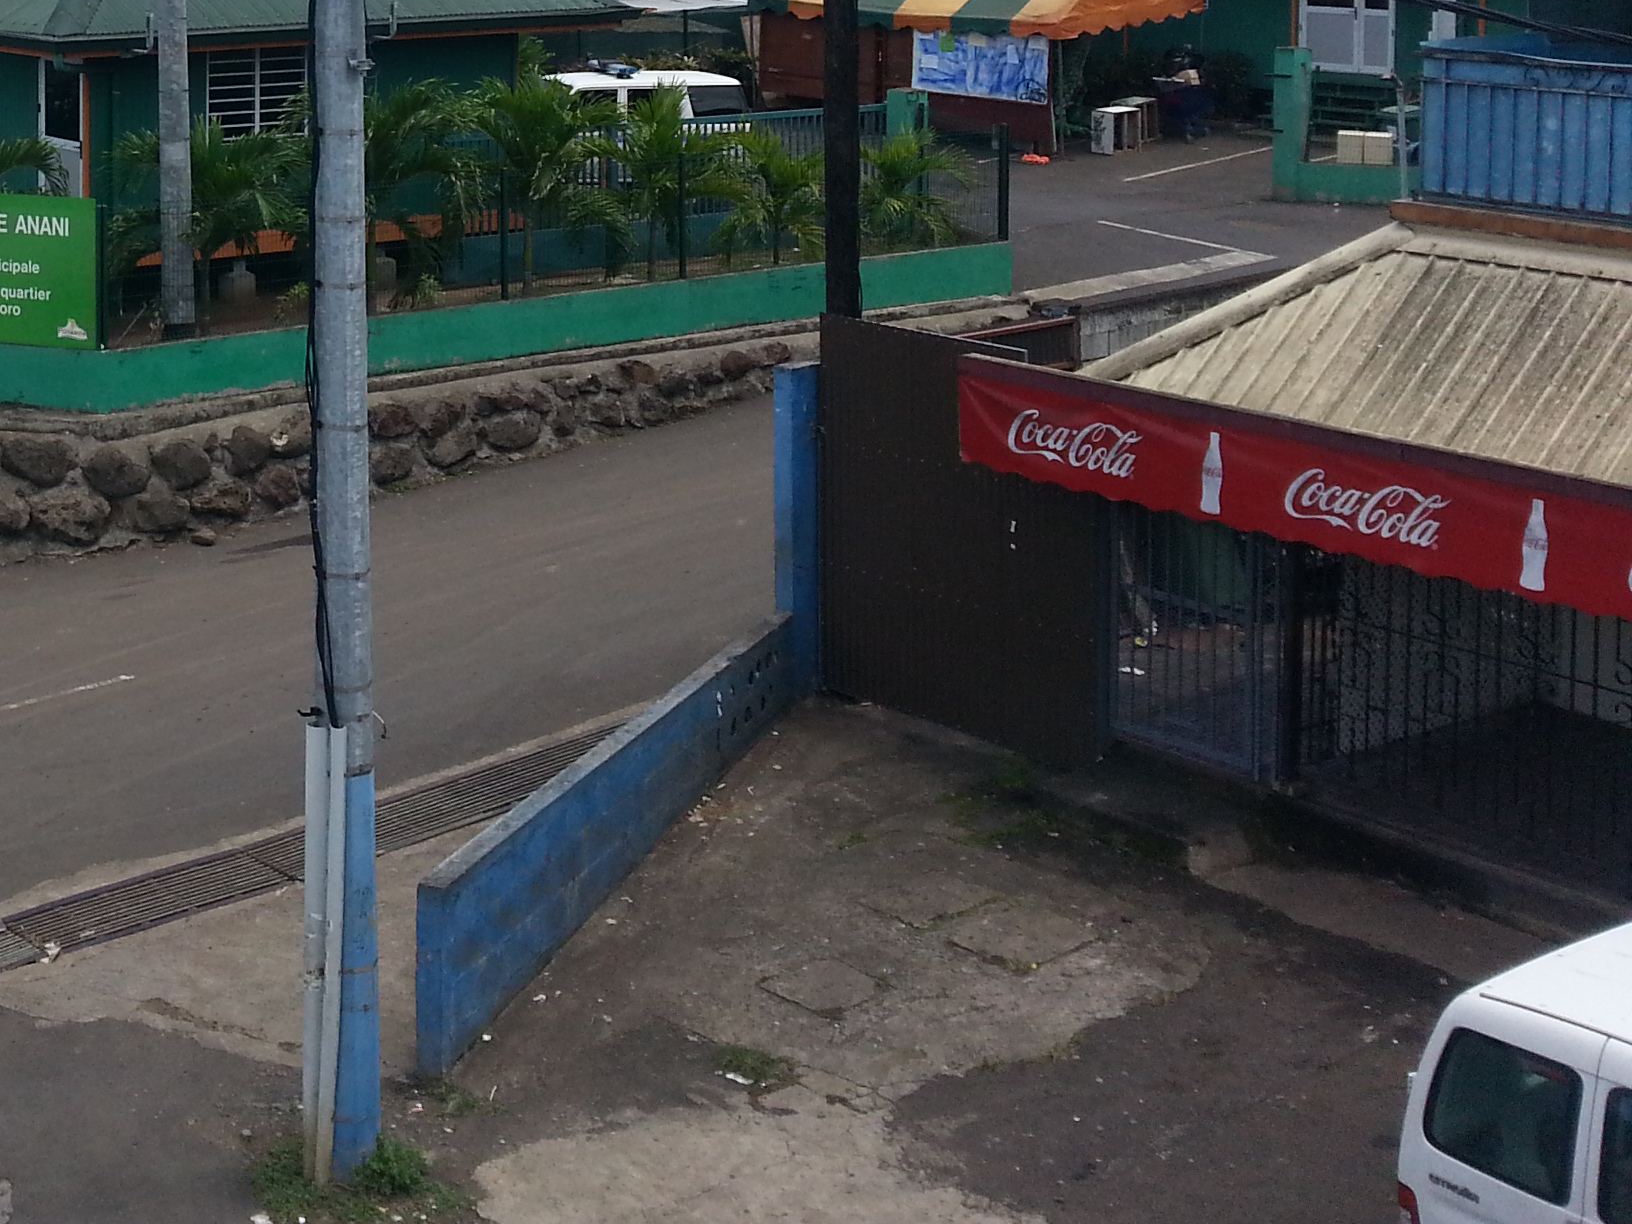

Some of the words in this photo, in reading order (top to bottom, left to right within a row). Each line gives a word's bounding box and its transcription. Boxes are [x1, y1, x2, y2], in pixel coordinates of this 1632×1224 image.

[14, 214, 70, 237] ANANI
[0, 287, 51, 301] quartier
[1007, 409, 1143, 478] Coca-Cola
[1284, 468, 1452, 548] Coca-Cola
